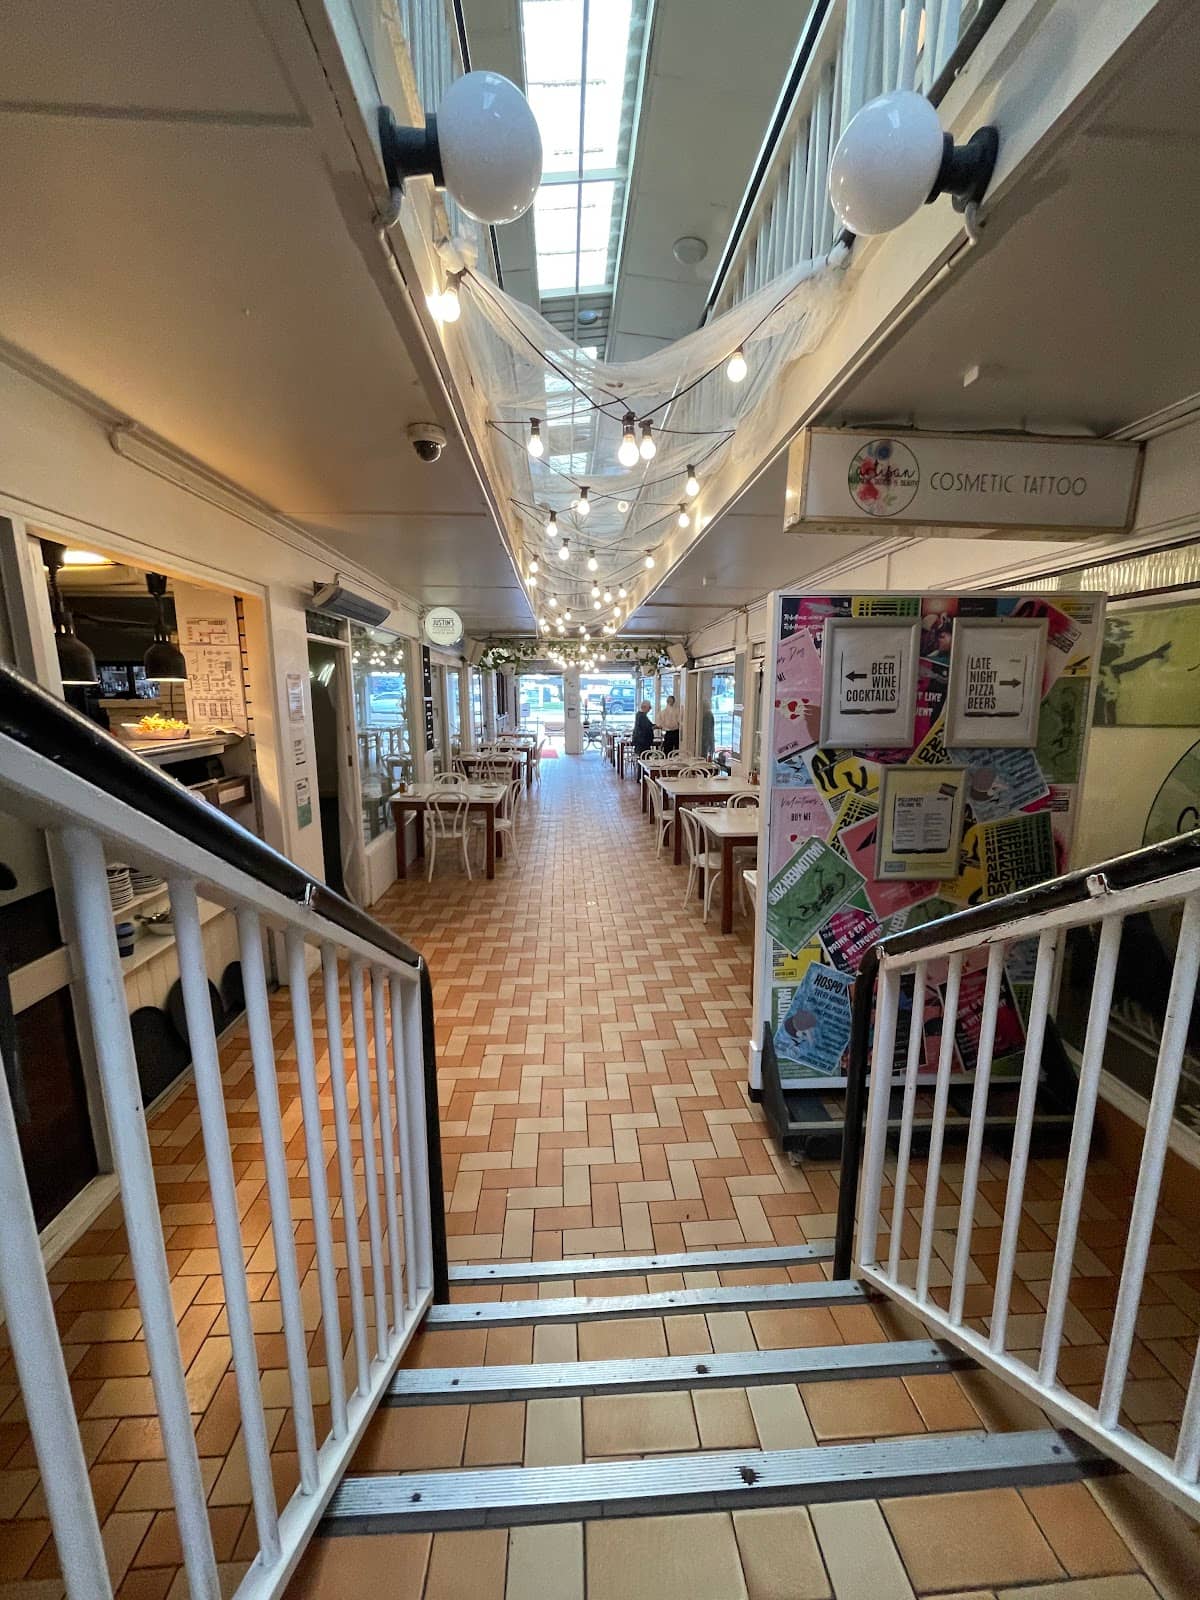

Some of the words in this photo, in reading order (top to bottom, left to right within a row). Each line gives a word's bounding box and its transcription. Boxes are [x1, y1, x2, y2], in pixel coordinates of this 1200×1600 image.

[930, 471, 1016, 493] COSMETIC
[1024, 475, 1087, 496] TATTOO
[872, 662, 895, 675] BEER
[970, 656, 992, 670] LATE
[872, 675, 897, 688] WINE
[969, 670, 998, 683] NIGHT
[846, 689, 896, 702] COCKTAILS
[924, 691, 943, 702] LIKE
[968, 684, 994, 697] PIZZA
[967, 697, 997, 709] BEERS
[827, 934, 849, 954] DRINK
[813, 974, 843, 994] HOSPO
